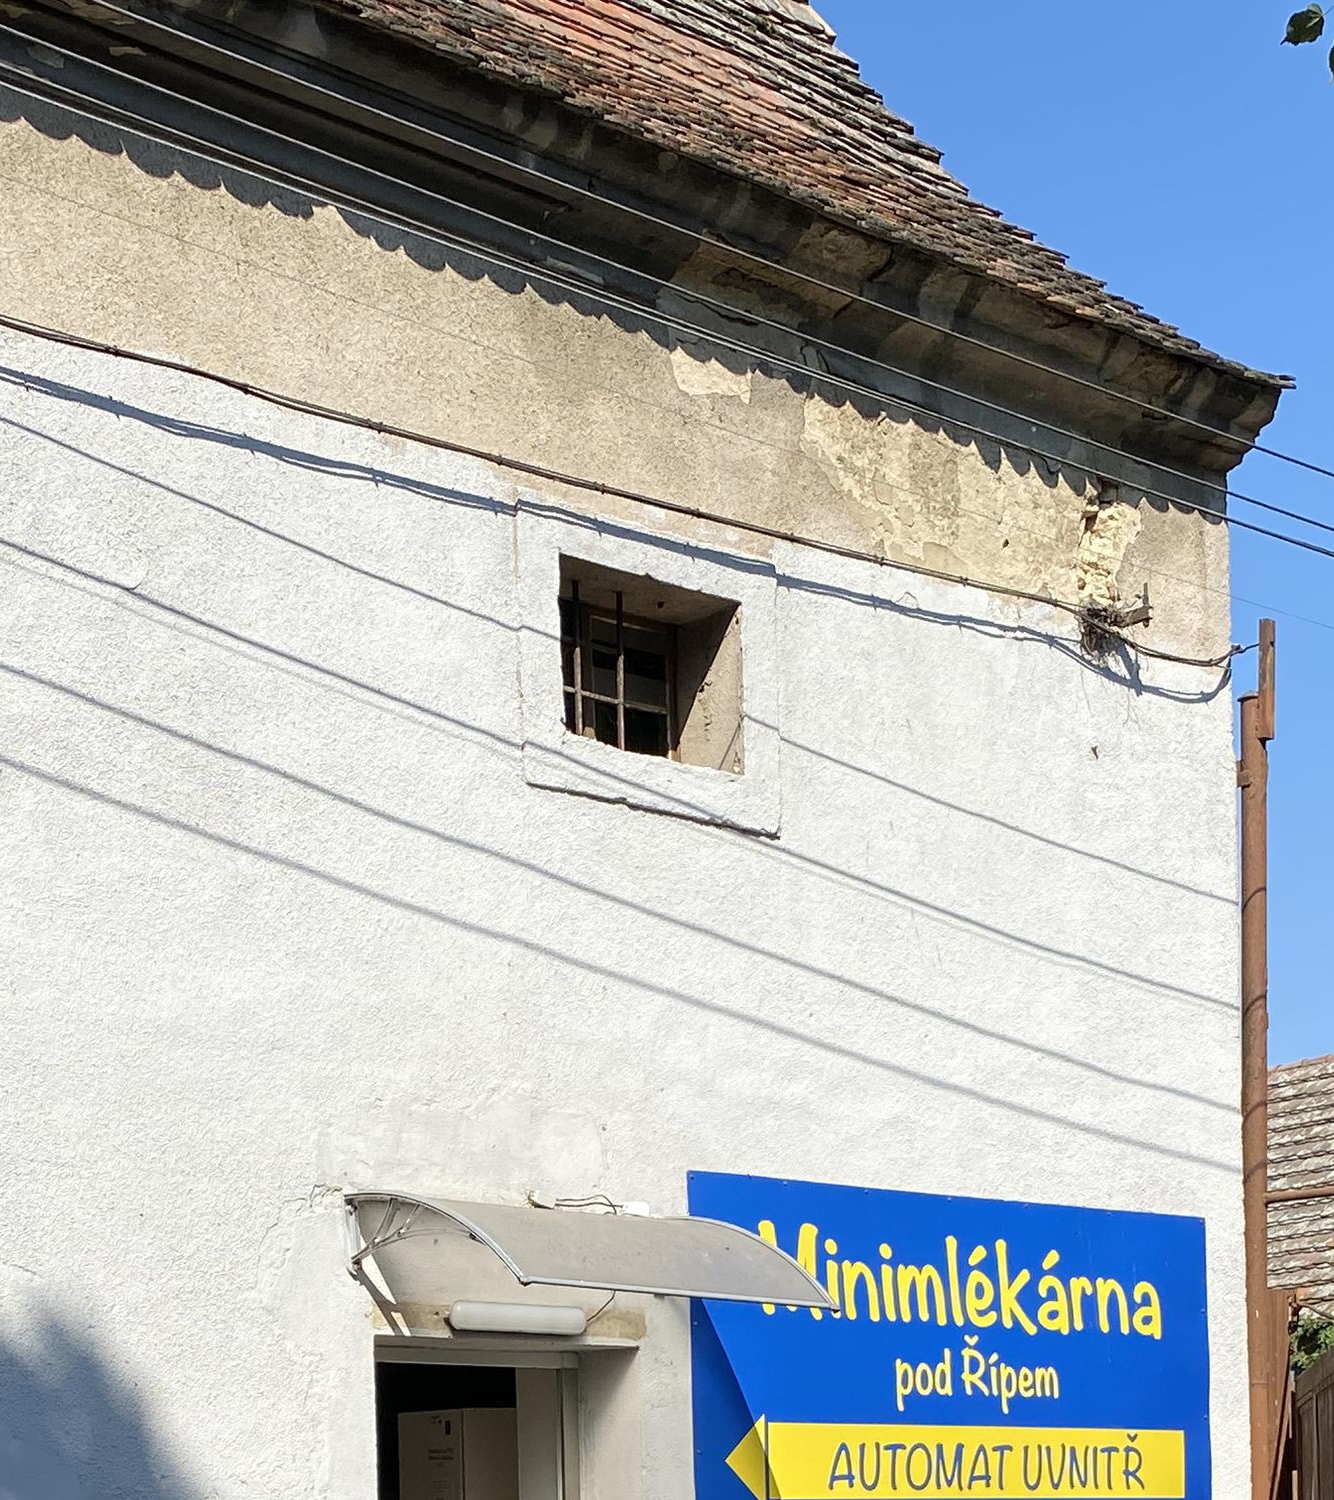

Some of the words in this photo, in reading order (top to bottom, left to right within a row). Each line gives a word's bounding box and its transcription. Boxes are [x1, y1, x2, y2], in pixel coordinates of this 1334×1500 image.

[895, 1348, 953, 1411] pod
[961, 1334, 1059, 1414] Řípem
[828, 1442, 1013, 1491] AUTOMAT
[1022, 1432, 1145, 1490] UVNITŘ
